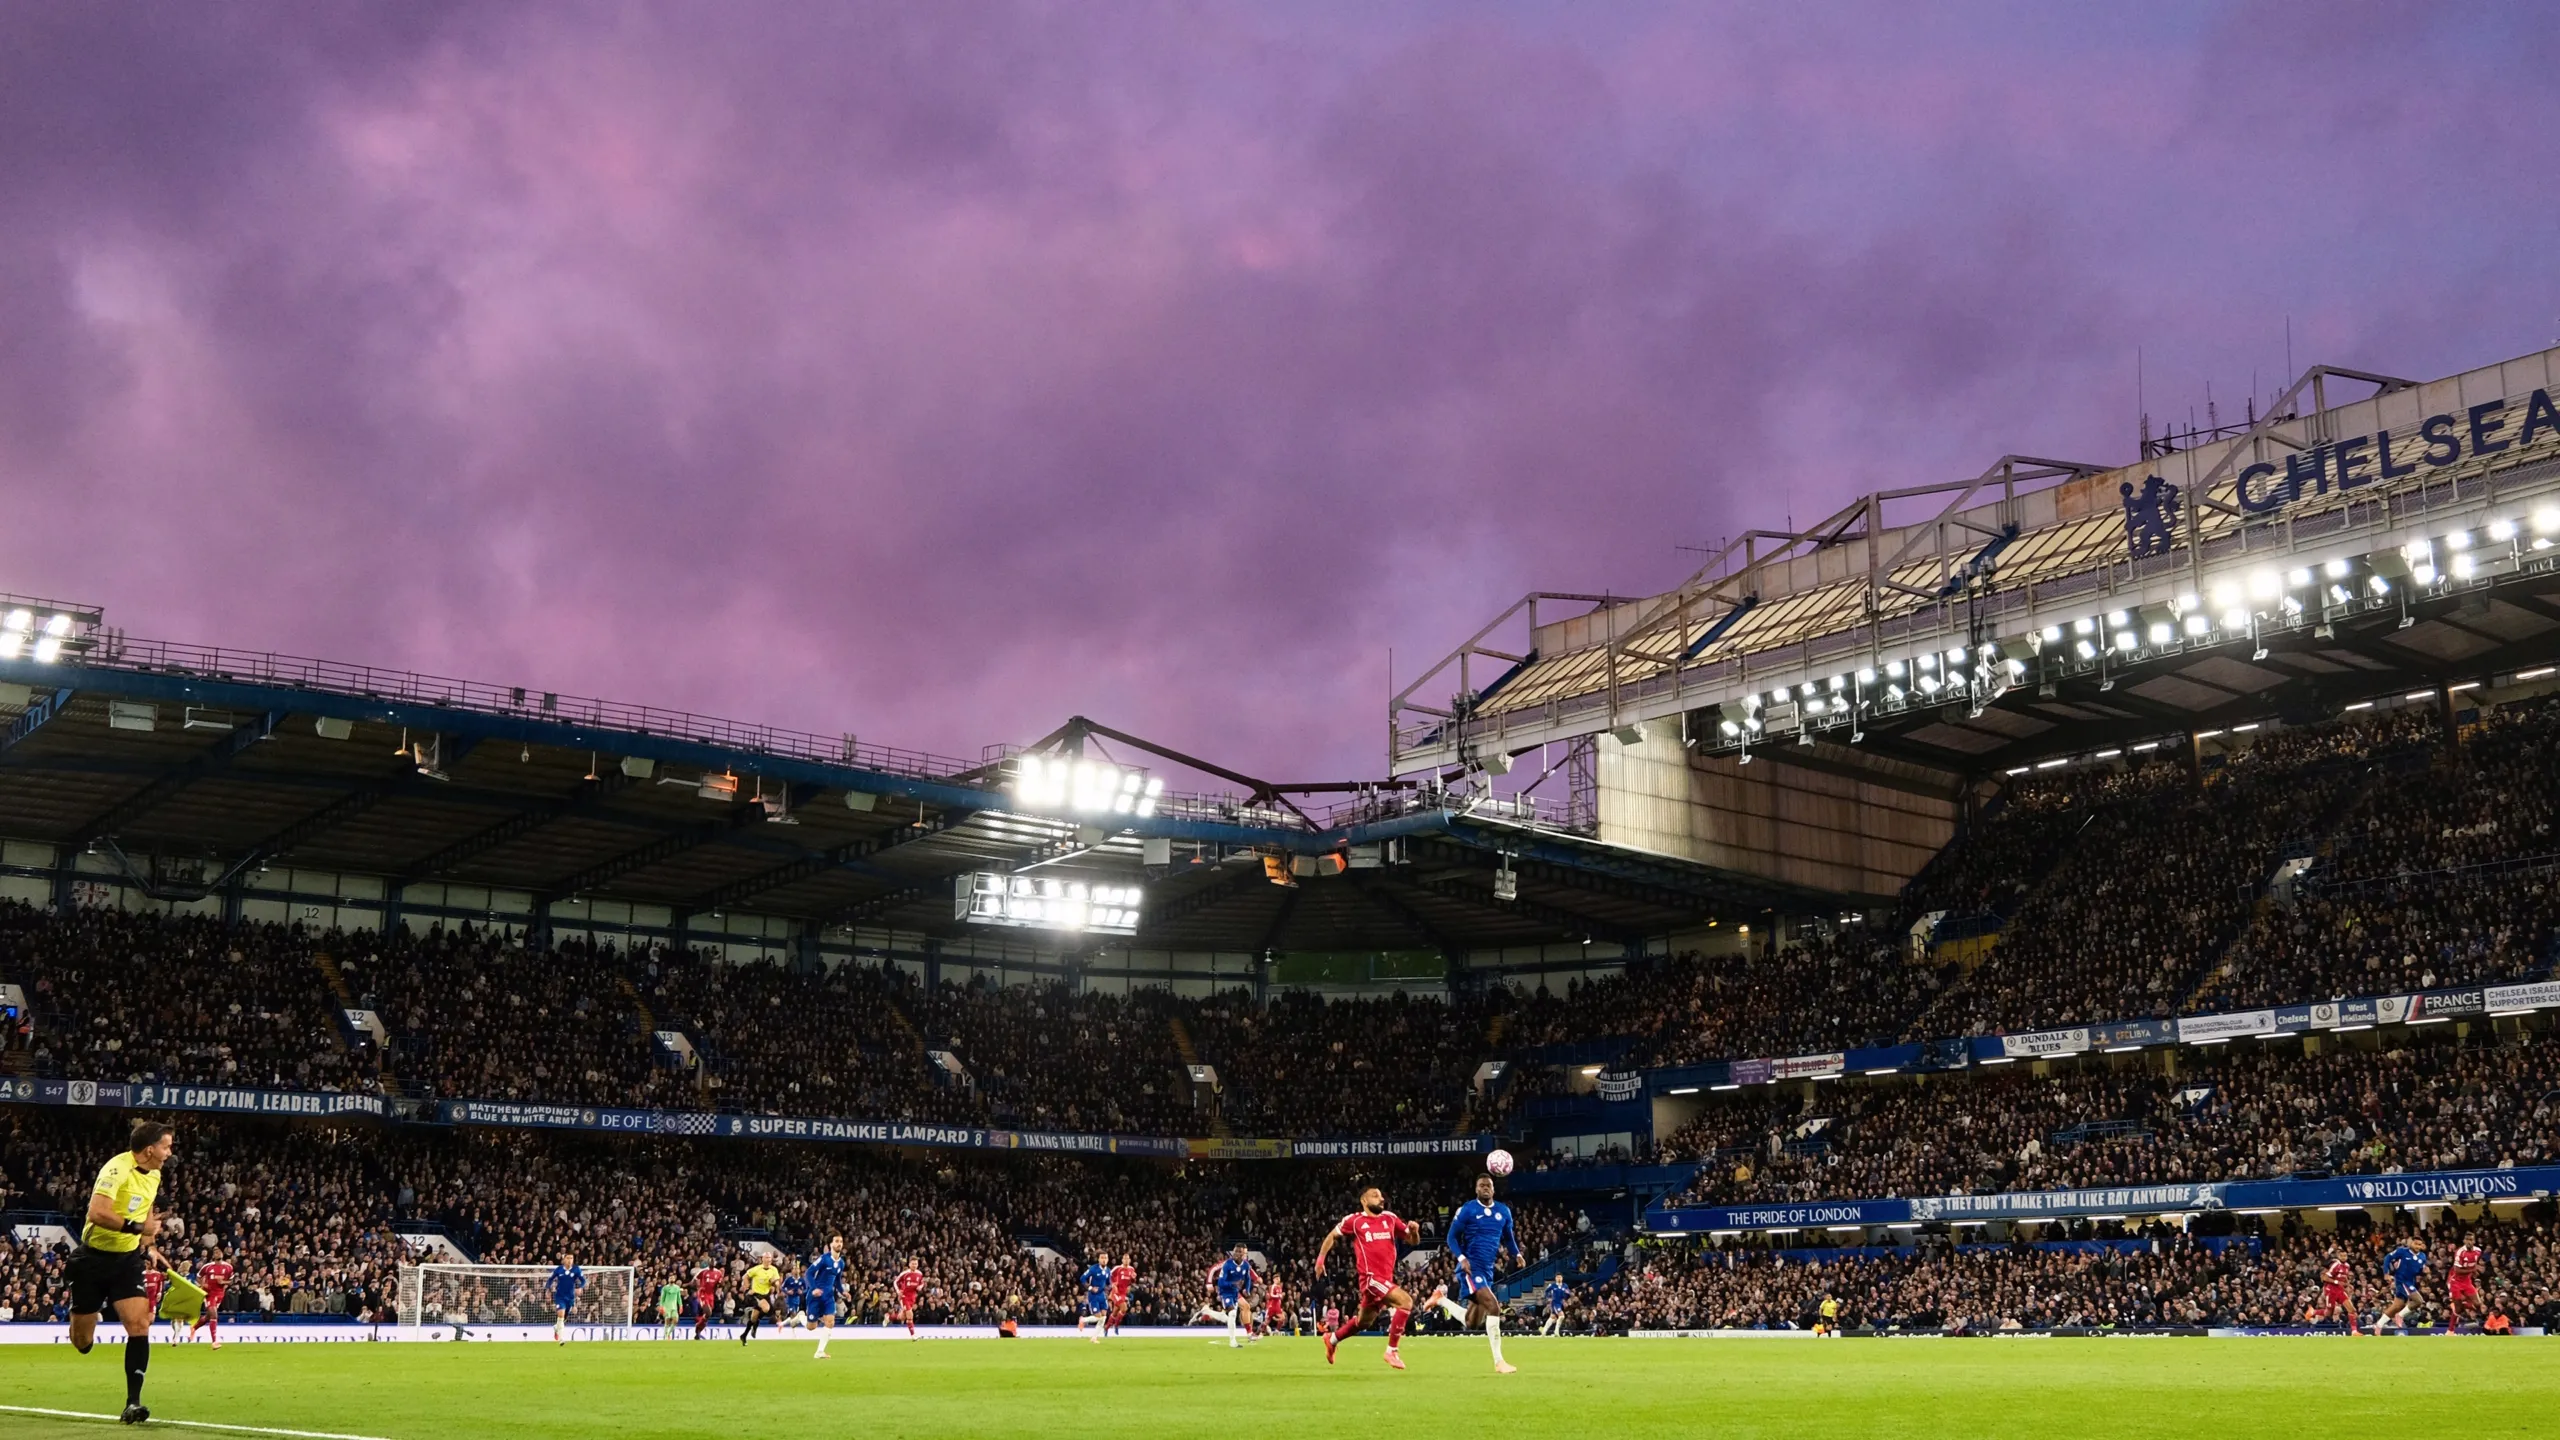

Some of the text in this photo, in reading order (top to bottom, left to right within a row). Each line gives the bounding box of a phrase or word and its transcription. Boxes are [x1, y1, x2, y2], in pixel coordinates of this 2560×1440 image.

[2236, 388, 2560, 514] CHELSEA
[2299, 860, 2304, 868] 2
[305, 908, 319, 918] 12
[2489, 988, 2528, 999] CHELSEA
[2425, 992, 2481, 1009] FRANCE
[2490, 996, 2547, 1007] SUPPORTERS
[2347, 1004, 2367, 1012] West
[2426, 1006, 2465, 1016] SUPPORTERS
[352, 1011, 364, 1021] 12
[2277, 1015, 2309, 1025] Chelsea
[2342, 1013, 2375, 1022] Midlands
[2020, 1031, 2069, 1045] DUNDALK
[2028, 1042, 2061, 1053] BLUES
[1801, 1060, 1827, 1072] BLUES
[0, 1081, 13, 1092] A
[45, 1087, 63, 1095] 547
[99, 1088, 122, 1097] SW6
[161, 1088, 383, 1115] JT CAPTAIN, LEADER, LEGEND
[468, 1103, 580, 1117] MATTHEW HARDING'S
[470, 1112, 577, 1125] BLUE & WHITE ARMY
[602, 1115, 620, 1128] DE
[623, 1115, 641, 1128] OF
[750, 1119, 968, 1144] SUPER FRANKIE LAMPARD
[975, 1133, 982, 1146] 8
[1023, 1134, 1058, 1149] TAKING
[1060, 1136, 1076, 1149] THE
[1078, 1136, 1103, 1151] MIKEL
[1294, 1139, 1477, 1155] LONDON'S FIRST, LONDON'S FINEST
[2346, 1175, 2517, 1199] WORLD CHAMPIONS
[1945, 1187, 2190, 1211] THEY DON'T MAKE THEM LIKE RAY ANYMORE
[1727, 1206, 1861, 1225] THE PRIDE OF LONDON
[28, 1227, 40, 1237] 11
